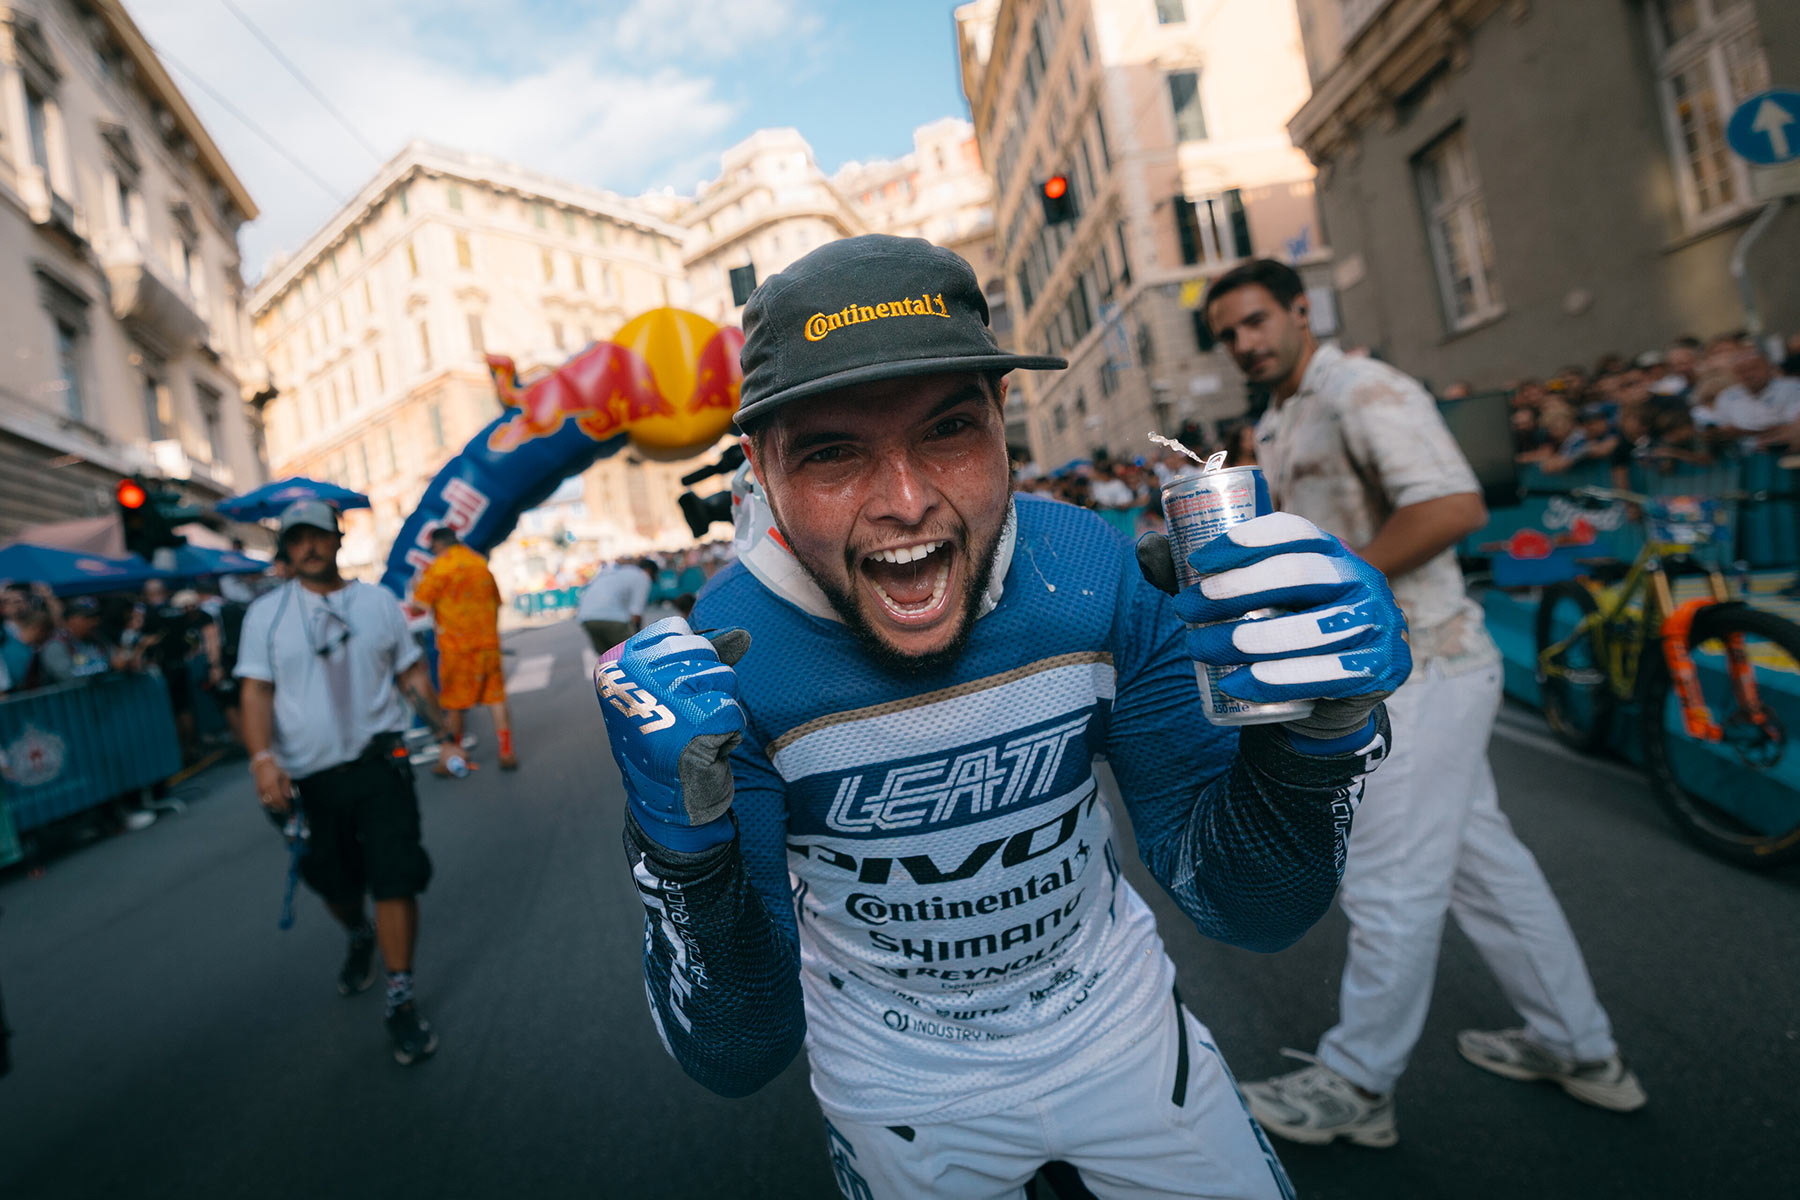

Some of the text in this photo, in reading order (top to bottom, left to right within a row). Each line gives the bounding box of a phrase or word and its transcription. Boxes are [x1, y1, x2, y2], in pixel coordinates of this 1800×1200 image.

[804, 294, 936, 342] Continental
[596, 659, 676, 735] LEA
[1214, 703, 1228, 714] 250
[1229, 704, 1240, 713] ml
[825, 713, 1093, 833] LEATT
[787, 787, 1099, 885] PIVO
[663, 880, 690, 925] RACIG
[845, 857, 1076, 925] Continental
[869, 887, 1086, 963] SHIMANO
[913, 1018, 981, 1041] INDUSTRY
